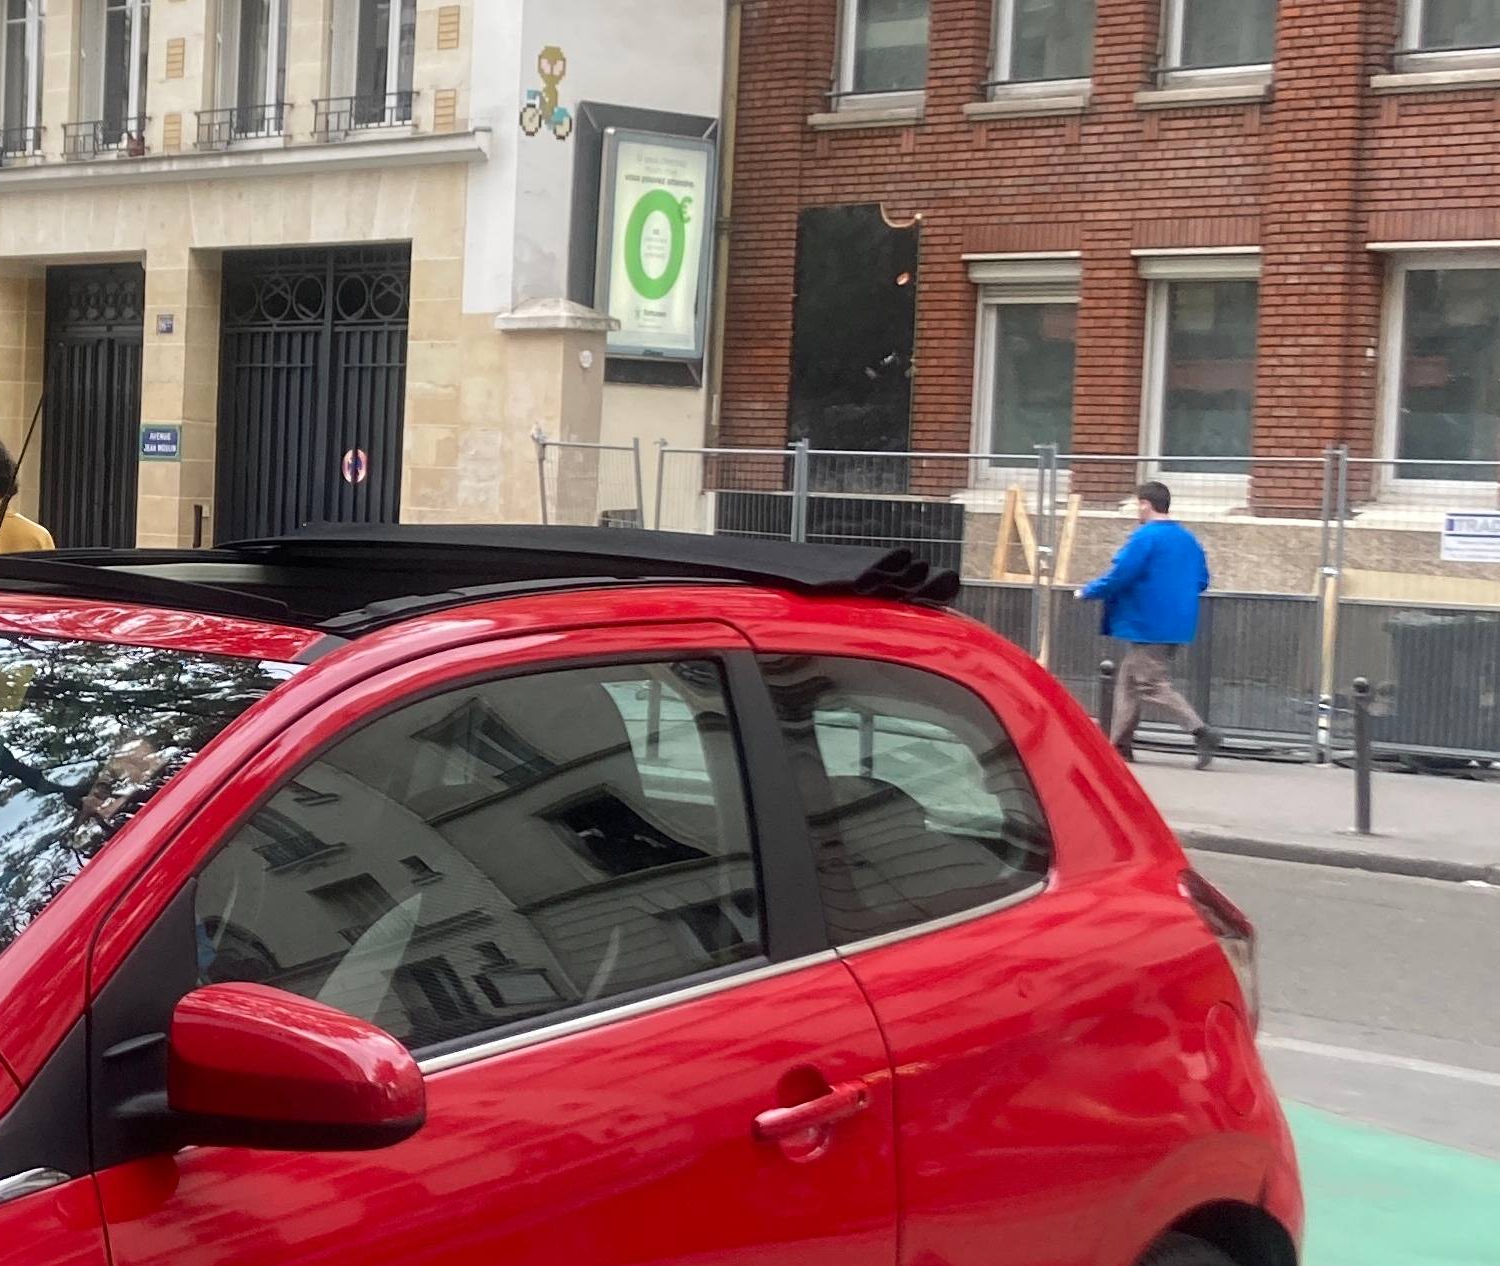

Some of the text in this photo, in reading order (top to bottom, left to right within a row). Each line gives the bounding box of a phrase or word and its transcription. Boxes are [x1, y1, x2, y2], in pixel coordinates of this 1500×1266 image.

[149, 432, 171, 441] AVENUE
[143, 443, 177, 452] JEAN MOULIN
